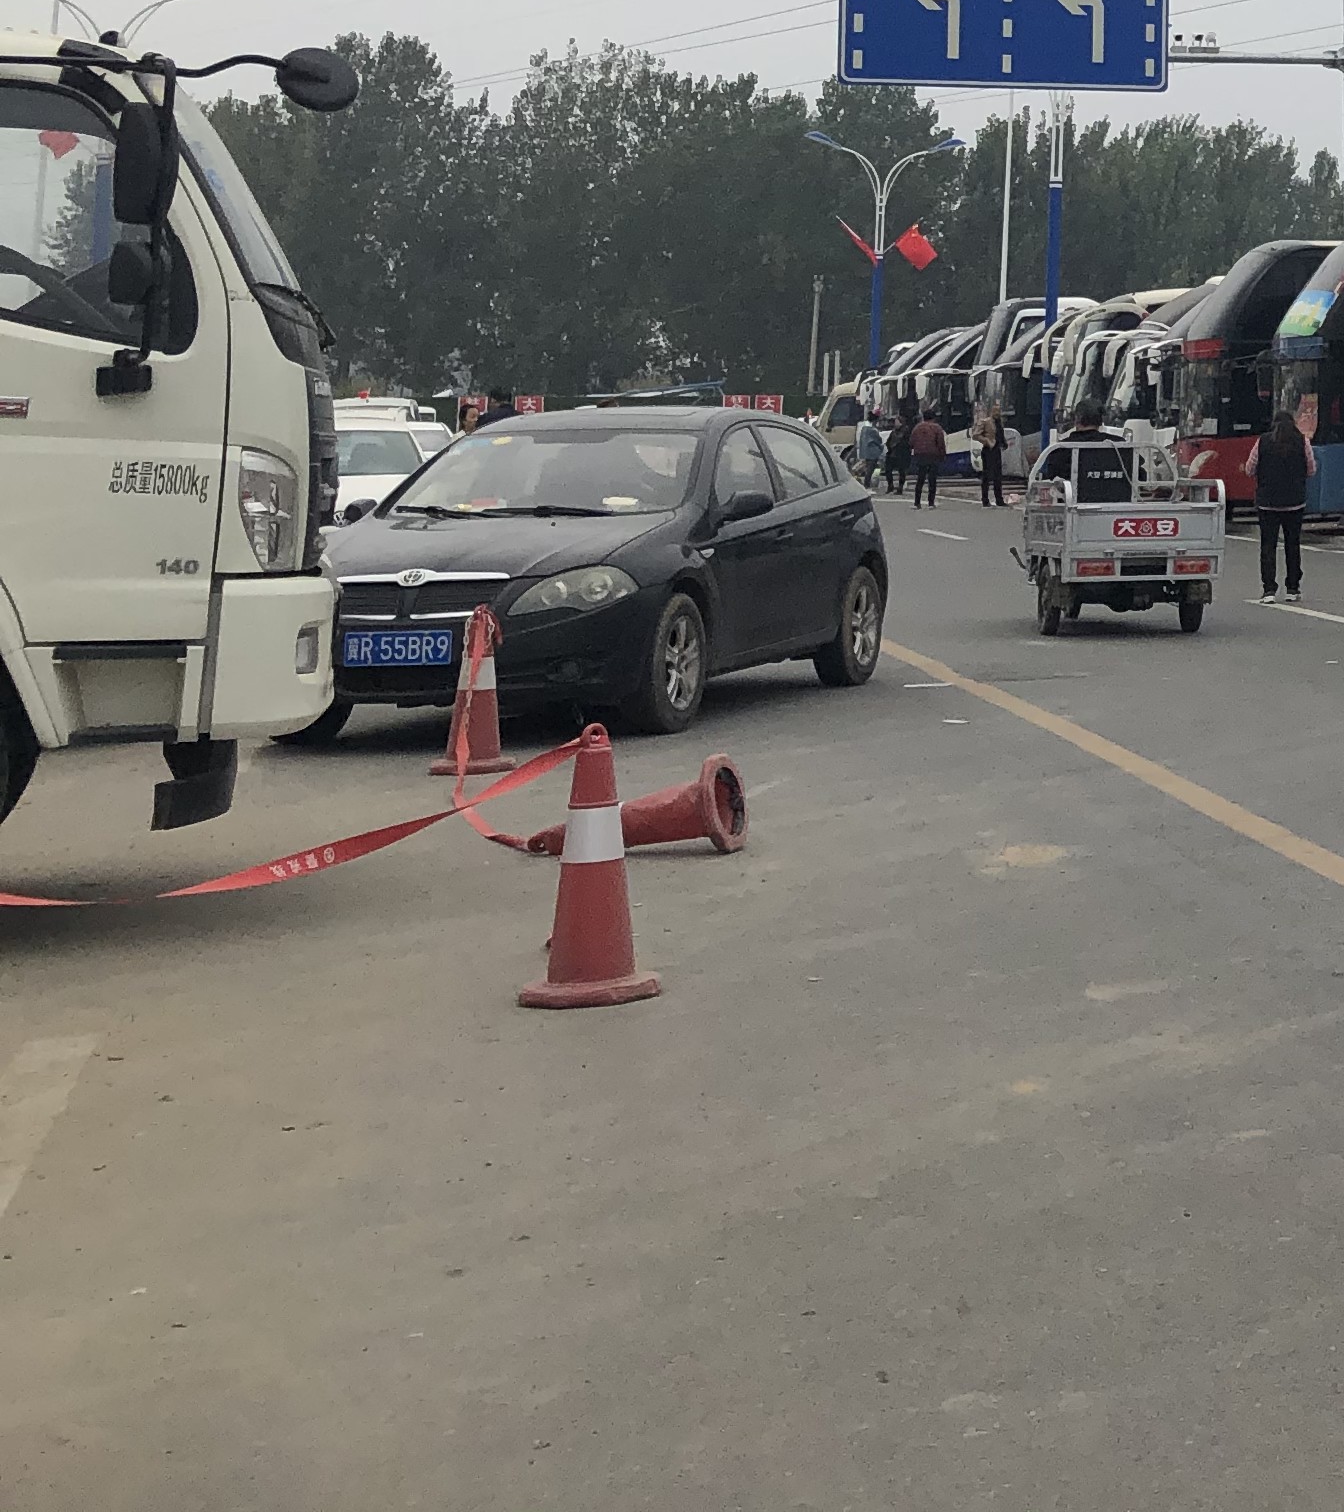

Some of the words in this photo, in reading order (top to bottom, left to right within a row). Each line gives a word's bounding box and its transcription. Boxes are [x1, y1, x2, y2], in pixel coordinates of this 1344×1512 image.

[108, 461, 210, 504] 总质量15800kg
[156, 557, 200, 575] 140
